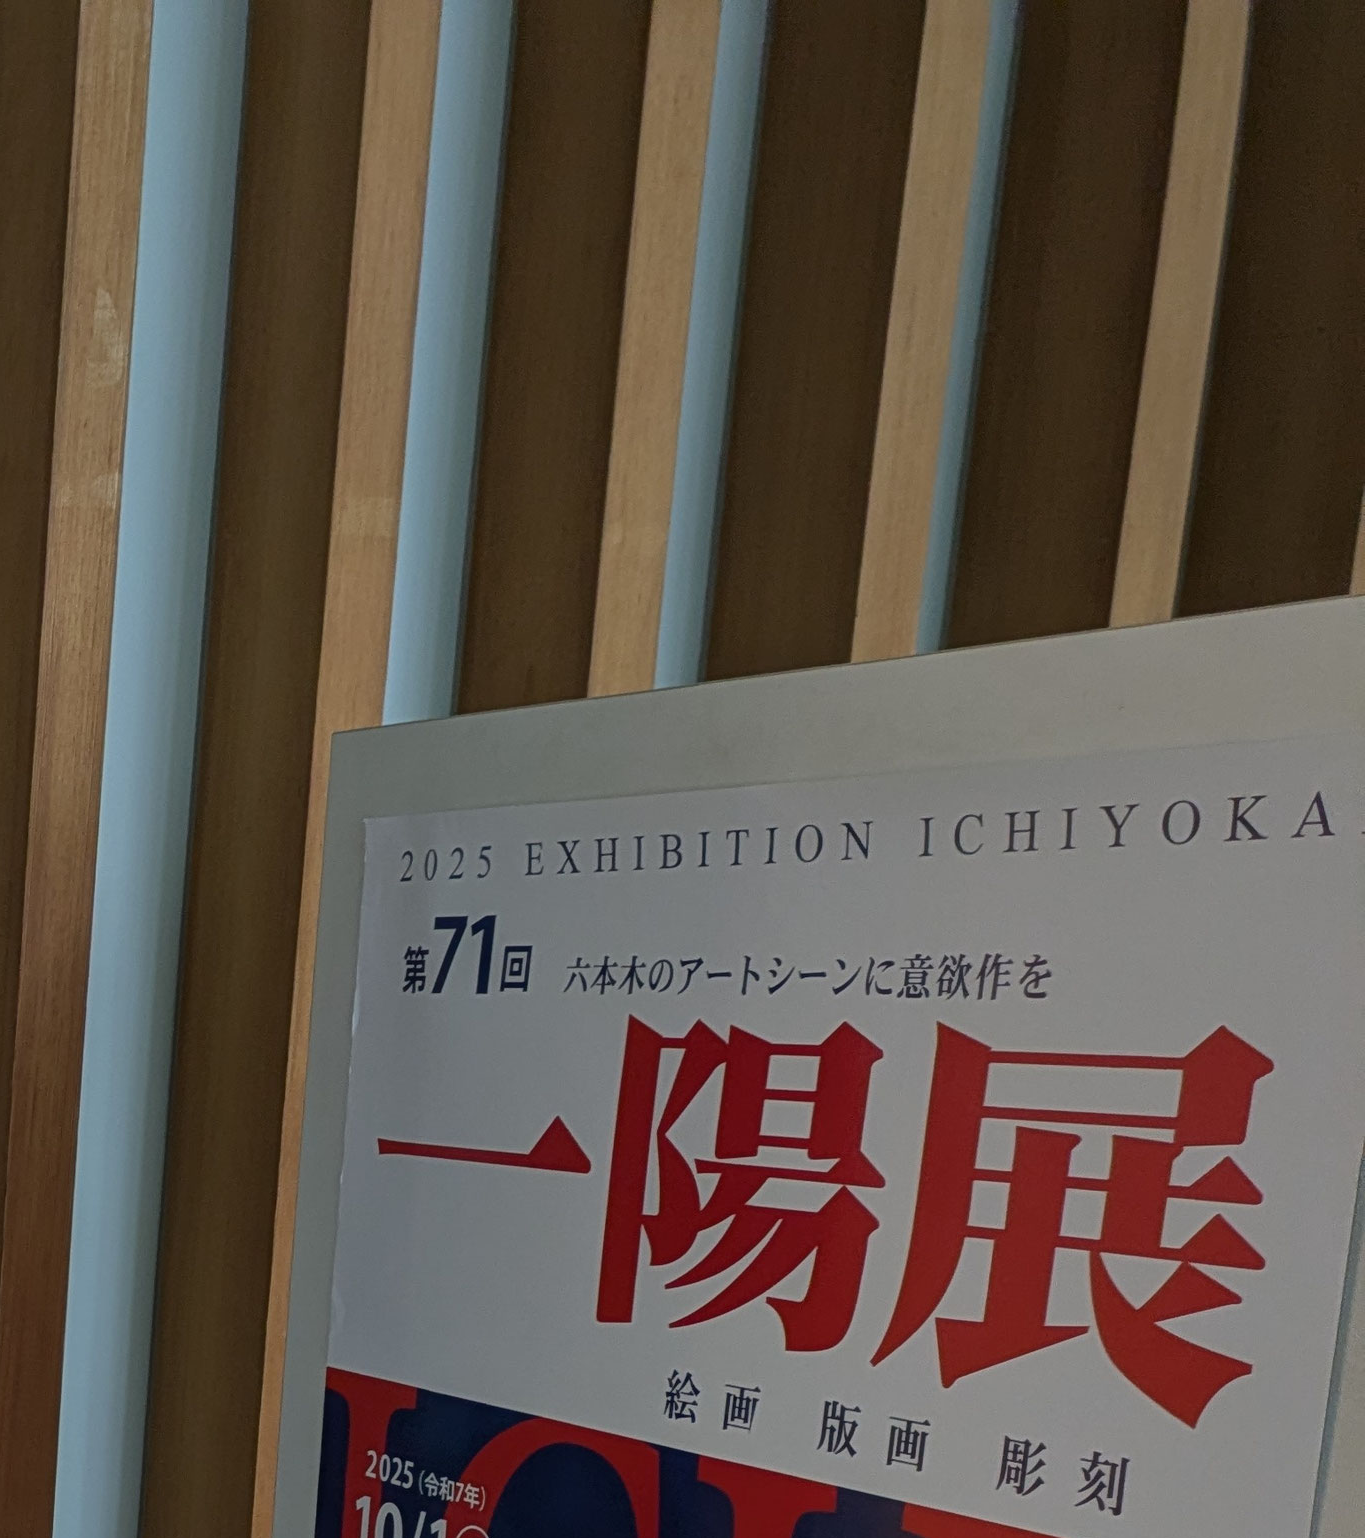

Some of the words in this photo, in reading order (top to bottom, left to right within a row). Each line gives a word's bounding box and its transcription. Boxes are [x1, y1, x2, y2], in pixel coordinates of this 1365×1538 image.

[399, 845, 494, 882] 2025
[524, 821, 874, 877] EXHIBITION
[919, 791, 1365, 857] ICHIYOKA
[401, 914, 534, 995] 第71回
[562, 952, 1053, 1001] 六本木のアートシーンに意欲作を
[377, 1013, 1275, 1430] 一陽展
[365, 1450, 414, 1490] 2025
[664, 1369, 762, 1432] 絵画
[815, 1401, 927, 1473] 版画
[995, 1435, 1131, 1518] 彫刻
